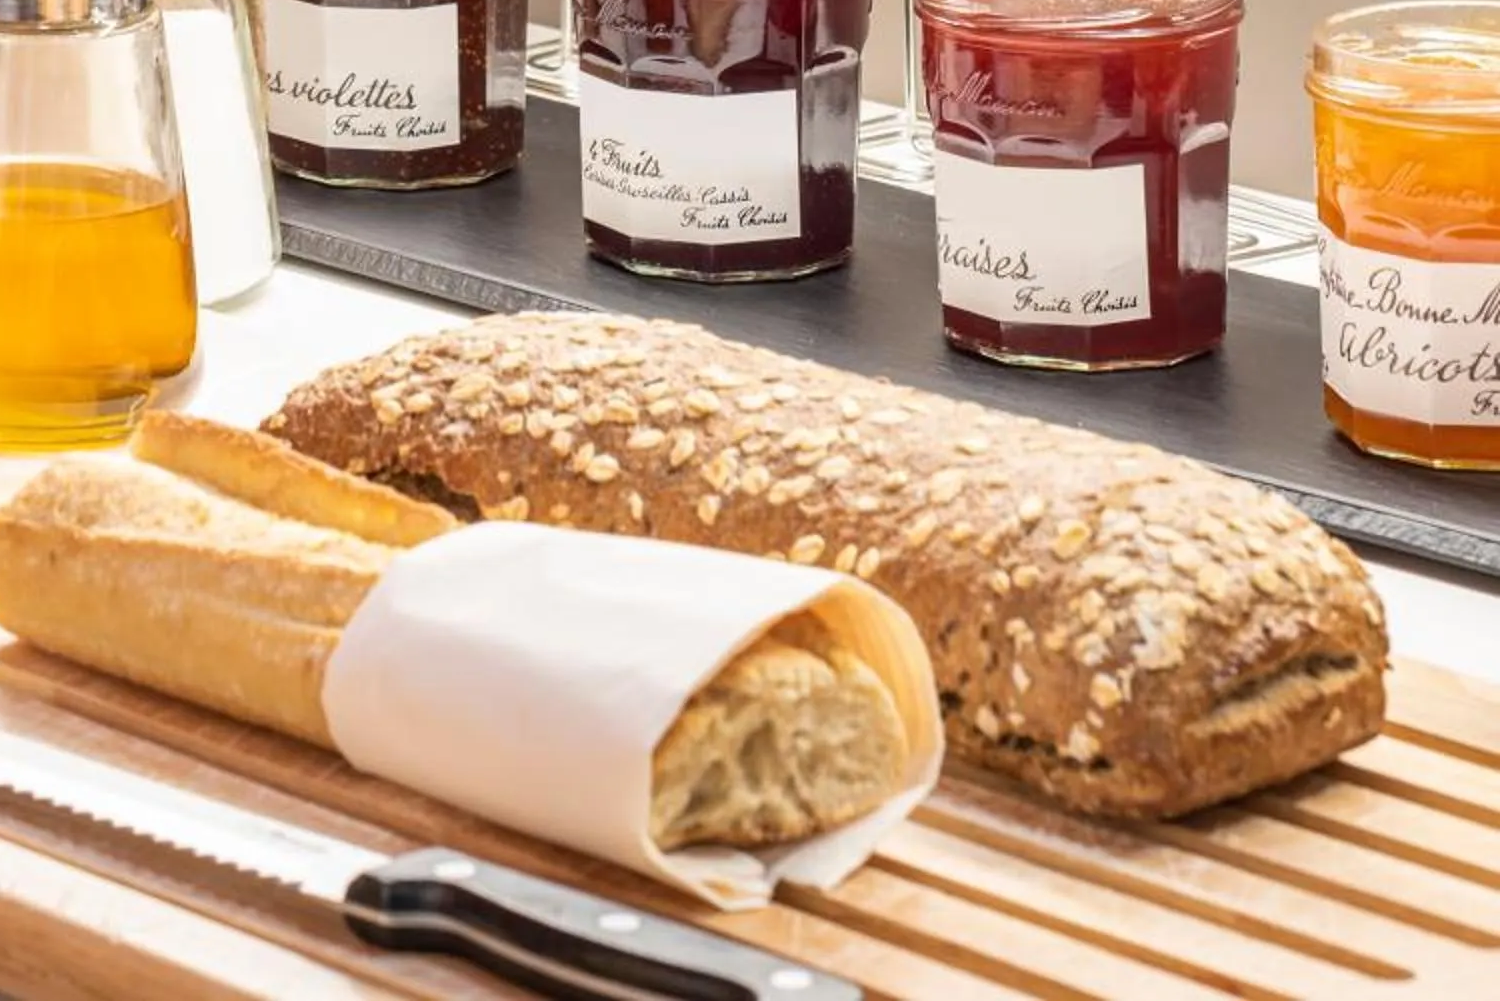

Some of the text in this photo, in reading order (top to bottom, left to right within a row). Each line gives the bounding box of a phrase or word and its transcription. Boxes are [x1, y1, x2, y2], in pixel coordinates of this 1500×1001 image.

[293, 72, 418, 110] violettes
[333, 114, 387, 138] Fruits
[601, 138, 663, 178] Fruits
[680, 206, 731, 229] Fruits
[1013, 285, 1073, 314] Fruits
[1367, 266, 1458, 324] Bonne
